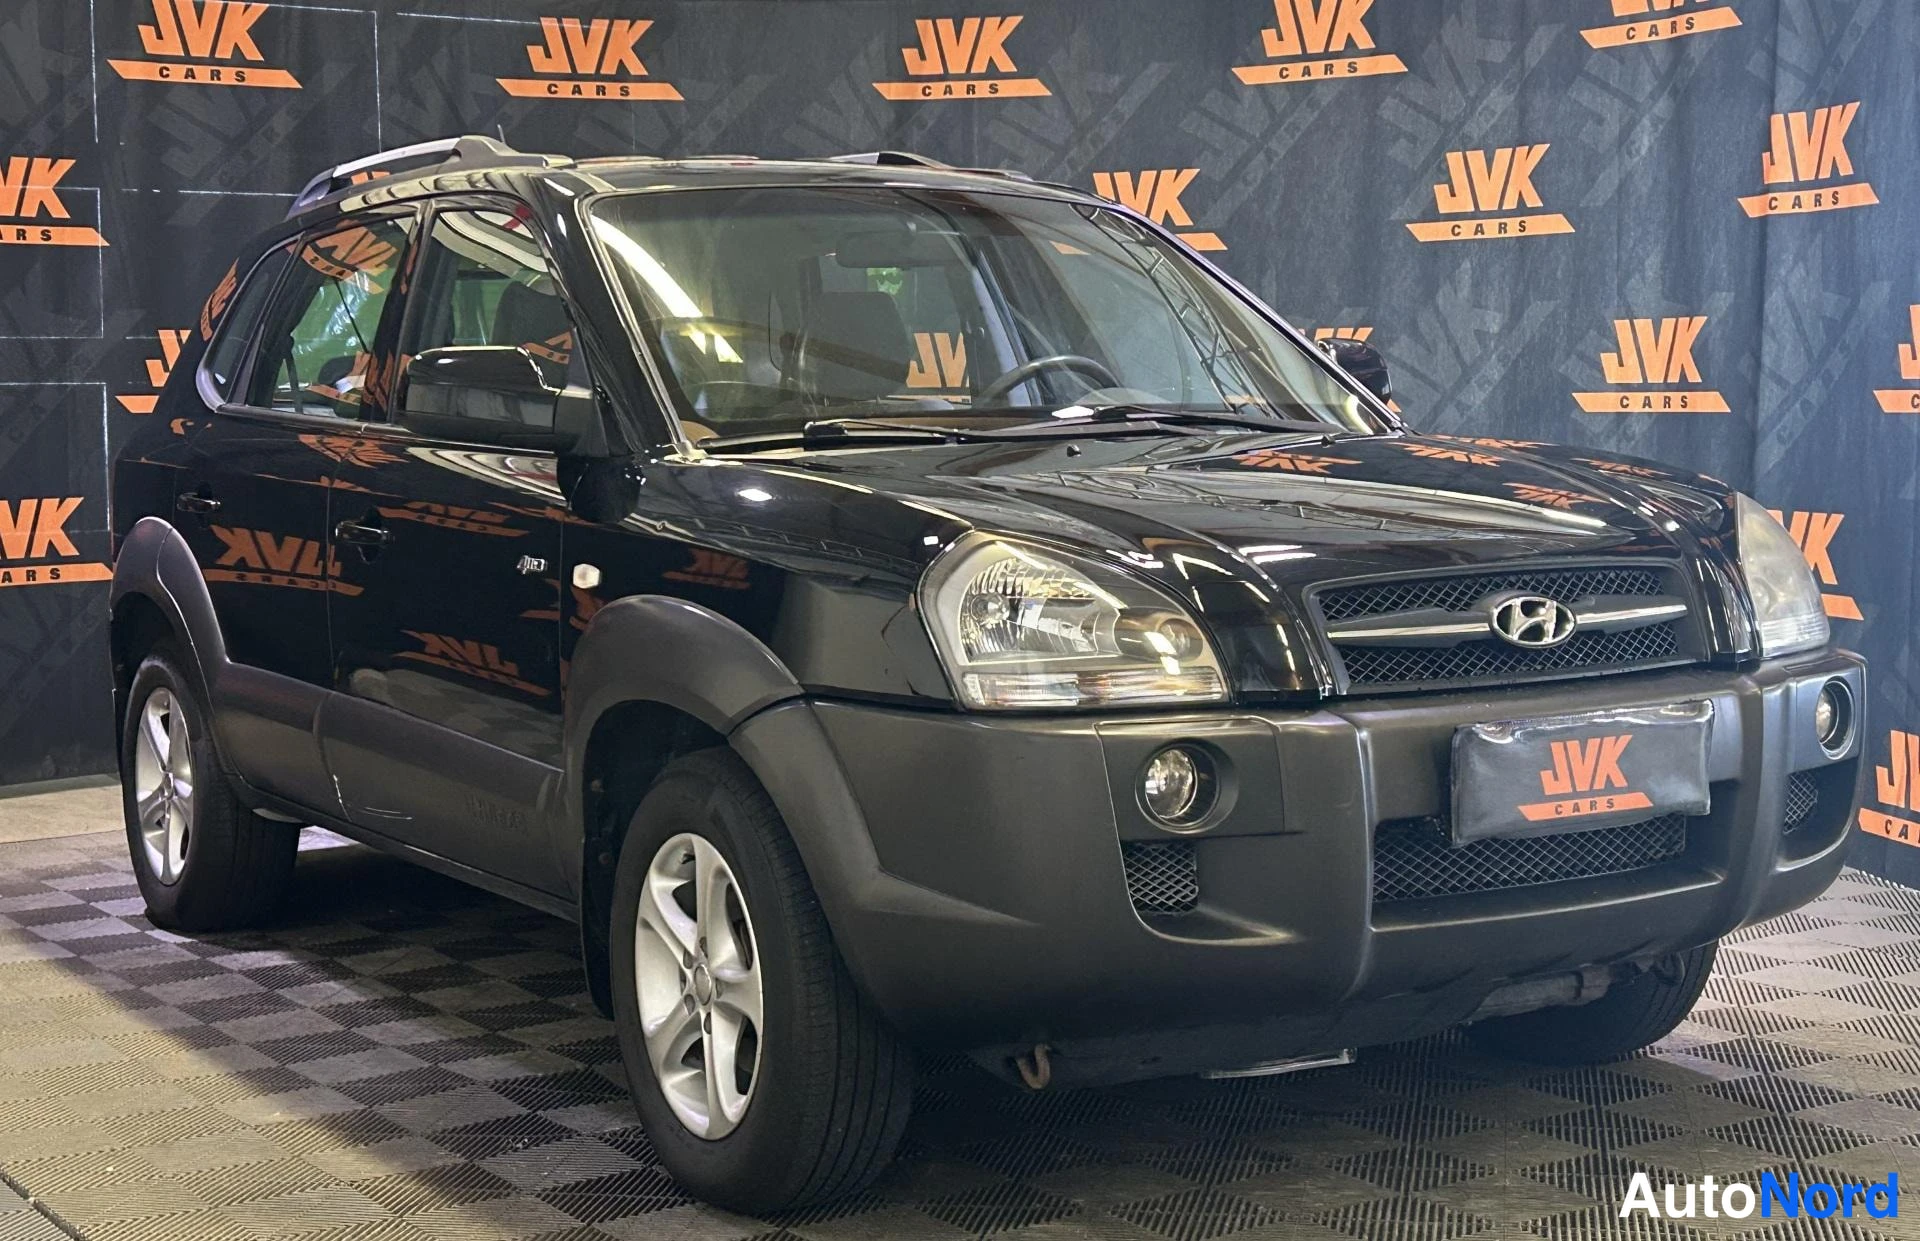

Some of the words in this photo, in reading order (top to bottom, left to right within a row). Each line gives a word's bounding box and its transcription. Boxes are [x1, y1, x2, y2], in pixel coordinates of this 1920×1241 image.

[137, 0, 269, 61] JVK
[526, 17, 654, 76] JVK
[902, 15, 1024, 76] JVK
[1260, 0, 1376, 57] JVK
[1625, 16, 1695, 41] CARS
[158, 65, 246, 83] CARS
[546, 83, 631, 97] CARS
[921, 83, 999, 97] CARS
[1278, 61, 1358, 80] CARS
[1762, 101, 1861, 184] JVK
[0, 156, 77, 219] VK
[1433, 143, 1551, 214] JVK
[1768, 190, 1840, 211] CARS
[1450, 219, 1527, 237] CARS
[905, 331, 970, 388] JV
[1600, 315, 1708, 384] JVK
[1619, 395, 1689, 409] CARS
[0, 496, 85, 559] VK
[0, 567, 61, 584] ARS
[1538, 734, 1634, 796] JVK
[1553, 799, 1616, 816] CARS
[1884, 818, 1920, 845] CA
